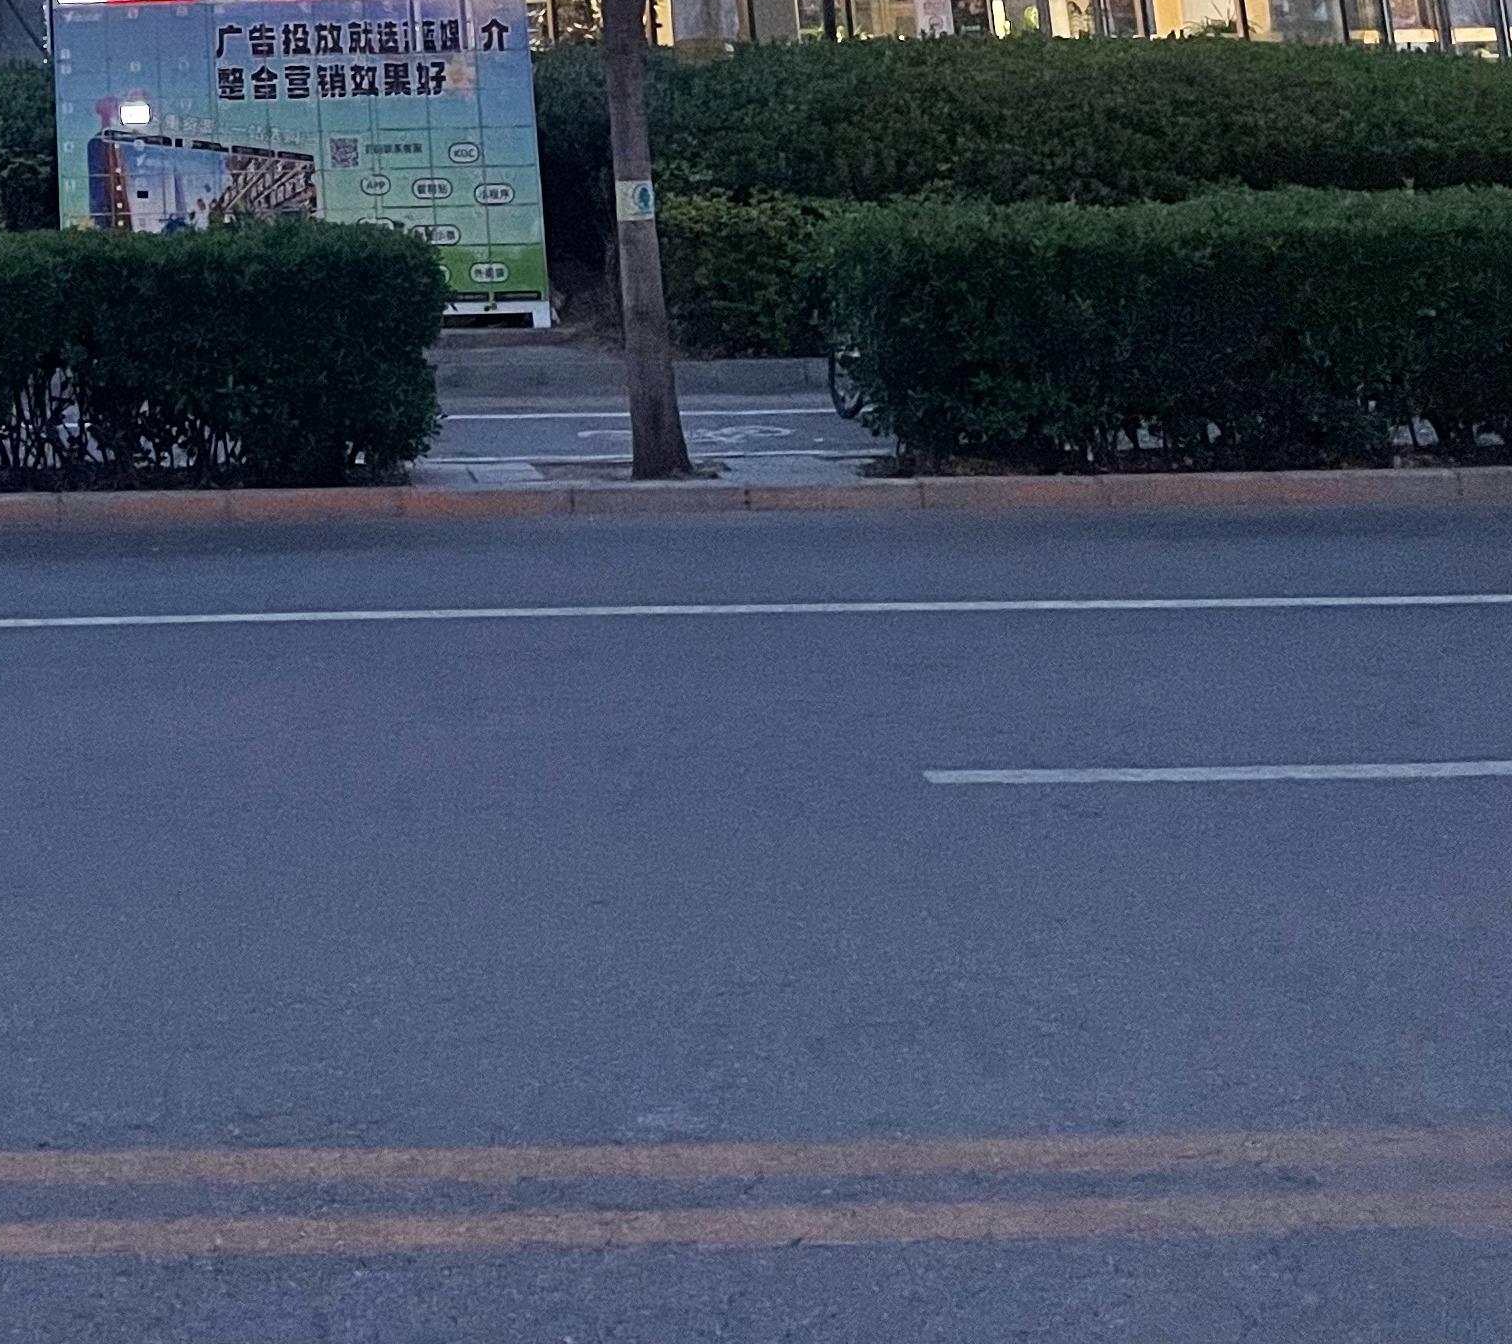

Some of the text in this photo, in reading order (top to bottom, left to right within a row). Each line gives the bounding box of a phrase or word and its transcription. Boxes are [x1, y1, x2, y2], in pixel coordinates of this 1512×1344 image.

[217, 62, 446, 100] 整合营销效果好
